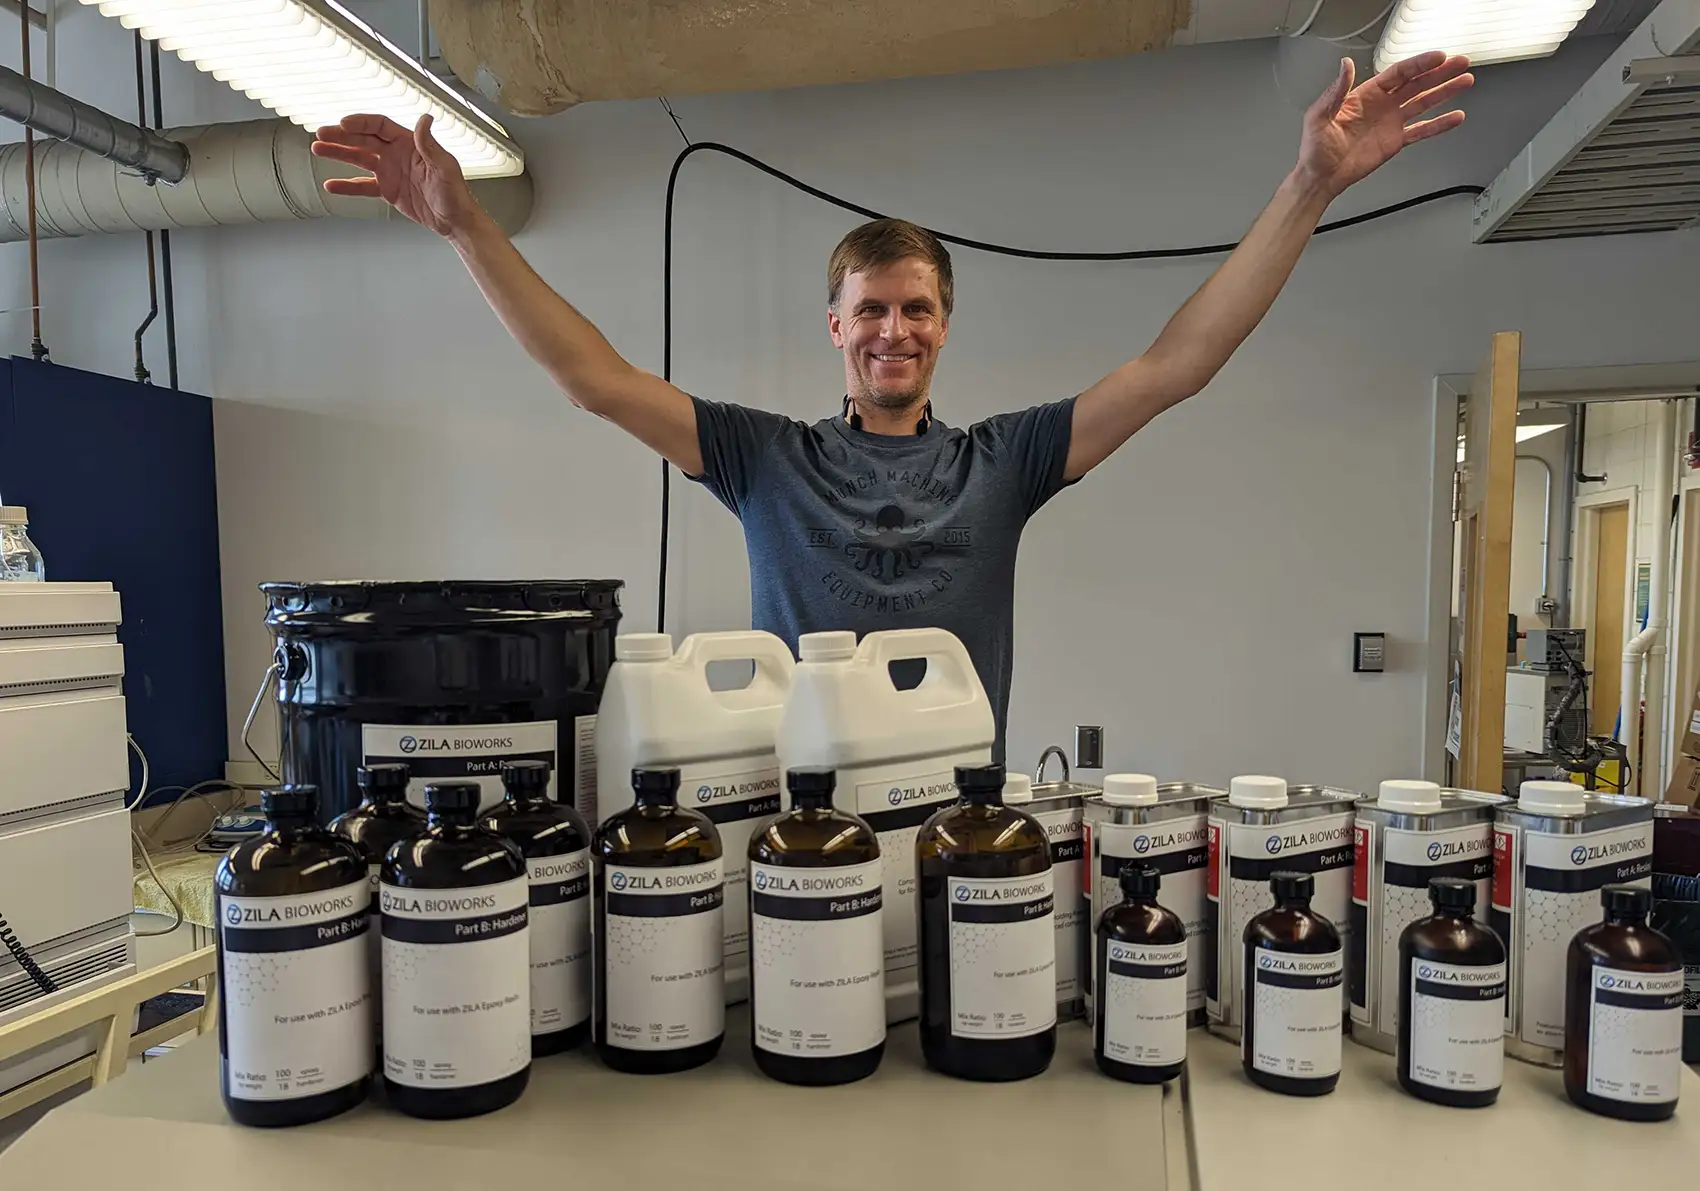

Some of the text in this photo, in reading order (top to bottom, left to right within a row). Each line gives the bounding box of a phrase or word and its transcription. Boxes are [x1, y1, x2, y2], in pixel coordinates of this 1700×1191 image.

[823, 469, 958, 507] MUNCH MACHINE
[944, 531, 970, 543] 2015
[821, 570, 926, 613] EQUIPMENT
[419, 737, 513, 750] ZILA BIOWORKS
[467, 761, 487, 771] Part
[713, 777, 779, 798] ZILA BIOWORKS
[903, 785, 926, 800] ZILA
[748, 801, 762, 814] Part
[1151, 834, 1175, 849] ZILA
[1283, 826, 1354, 849] ZILA BIOWORKS
[1058, 846, 1073, 857] Part
[1443, 843, 1465, 856] ZILA
[1588, 837, 1646, 860] ZILA BIOWORKS
[1188, 854, 1202, 865] Part
[1320, 855, 1336, 866] Part
[534, 858, 585, 878] BIOWORKS
[1473, 863, 1486, 875] Part
[1616, 867, 1630, 879] Part
[628, 876, 663, 889] ZILA
[665, 869, 717, 888] BIOWORKS
[768, 874, 864, 891] ZILA BIOWORKS
[559, 882, 576, 896] Part
[972, 882, 1045, 900] ZILA BIOWORKS
[393, 895, 496, 913] ZILA BIOWORKS
[690, 895, 708, 907] Part
[830, 901, 851, 913] Part
[851, 899, 860, 910] B:
[244, 895, 354, 923] ZILA BIOWORKS
[1024, 905, 1037, 916] Part
[317, 926, 340, 940] Part
[341, 922, 350, 936] B:
[455, 924, 480, 936] Part
[480, 921, 492, 933] B:
[1124, 950, 1182, 961] ZILA BIOWORKS
[1164, 967, 1175, 976] Part
[1272, 960, 1336, 971] ZILA BIOWORKS
[650, 974, 663, 982] For
[1316, 977, 1329, 985] Part
[1432, 969, 1500, 982] ZILA BIOWORKS
[790, 978, 802, 987] For
[818, 980, 835, 988] with
[836, 977, 852, 986] ZILA
[1616, 979, 1644, 991] ZILA
[1479, 988, 1492, 996] Part
[413, 1005, 425, 1014] For
[442, 1006, 461, 1014] with
[462, 1003, 480, 1013] ZILA
[274, 1016, 288, 1024] For
[290, 1014, 306, 1022] use
[306, 1010, 326, 1020] with
[789, 1029, 803, 1038] 100
[275, 1068, 291, 1078] 100
[278, 1082, 289, 1091] 18
